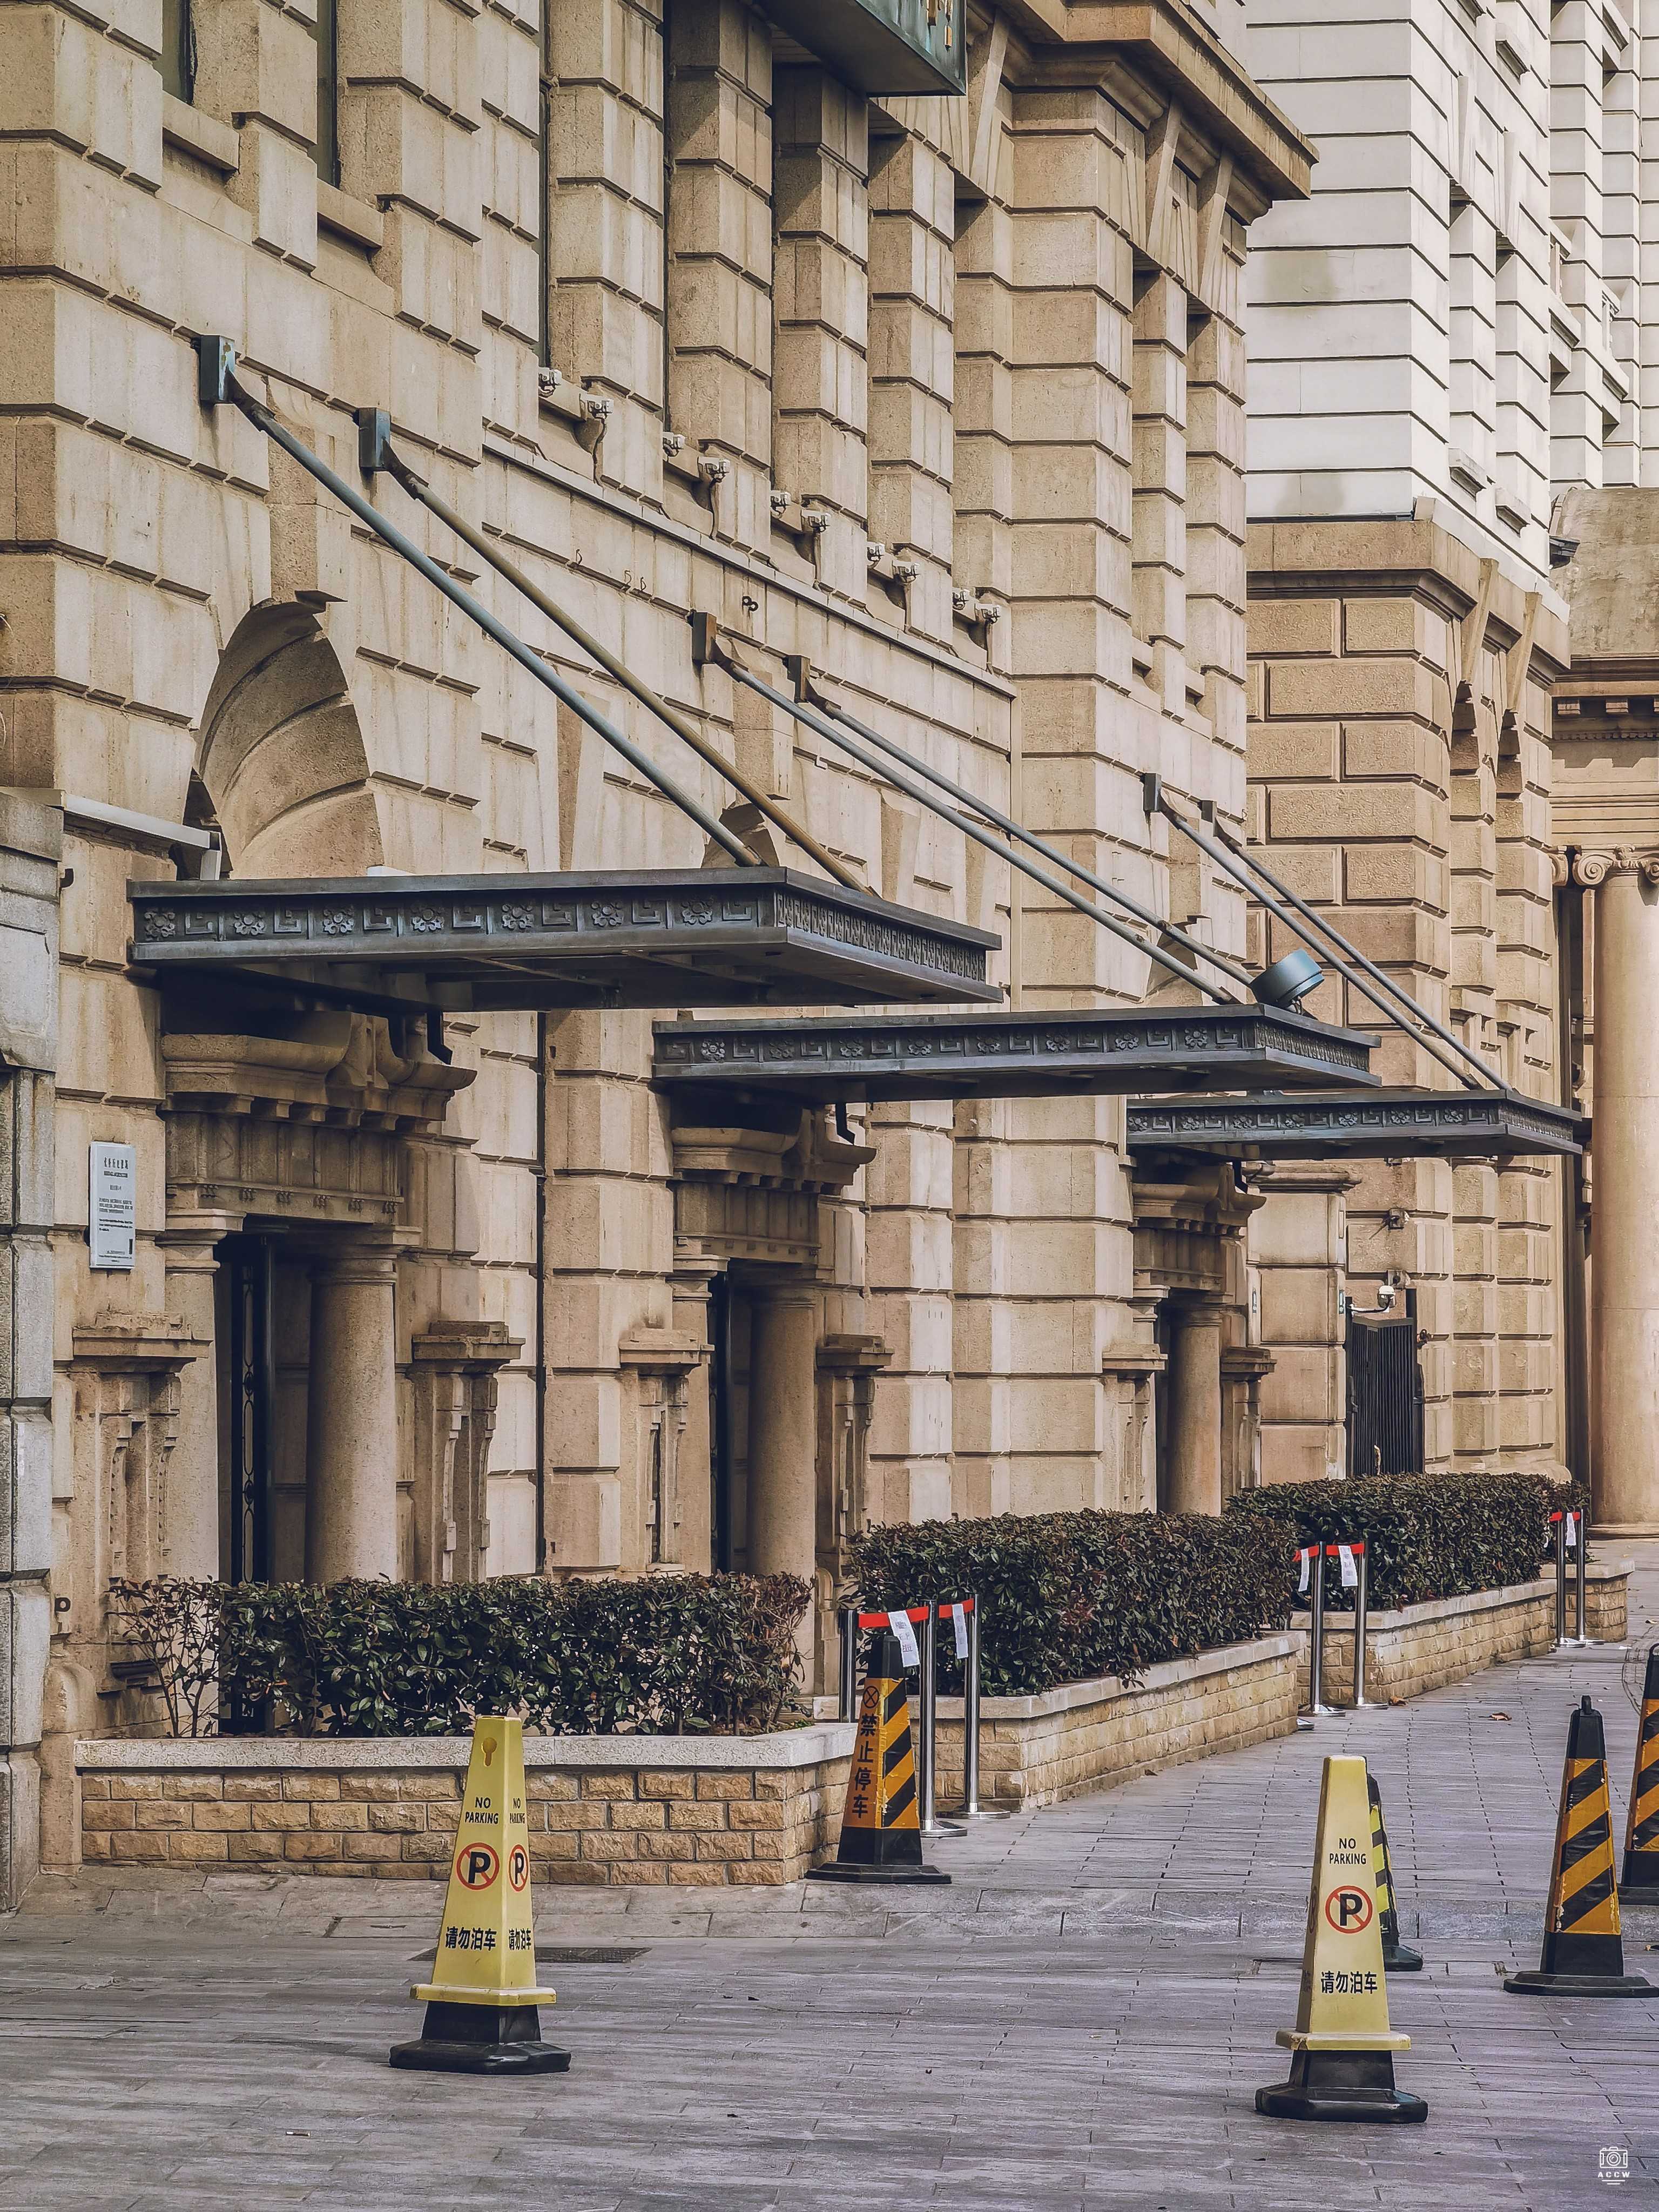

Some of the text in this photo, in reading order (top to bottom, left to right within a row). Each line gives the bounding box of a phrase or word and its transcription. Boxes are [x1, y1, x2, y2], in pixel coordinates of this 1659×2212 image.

[852, 1713, 876, 1819] 禁止停车
[475, 1797, 491, 1809] NO
[513, 1797, 521, 1809] NO
[464, 1812, 499, 1825] PARKING
[1338, 1838, 1357, 1850] NO
[468, 1851, 491, 1884] P
[1329, 1853, 1367, 1865] PARKING
[1339, 1893, 1363, 1926] P
[445, 1926, 497, 1951] 请勿泊车
[508, 1927, 532, 1952] 请勿泊车
[1320, 1970, 1378, 1994] 请勿泊车
